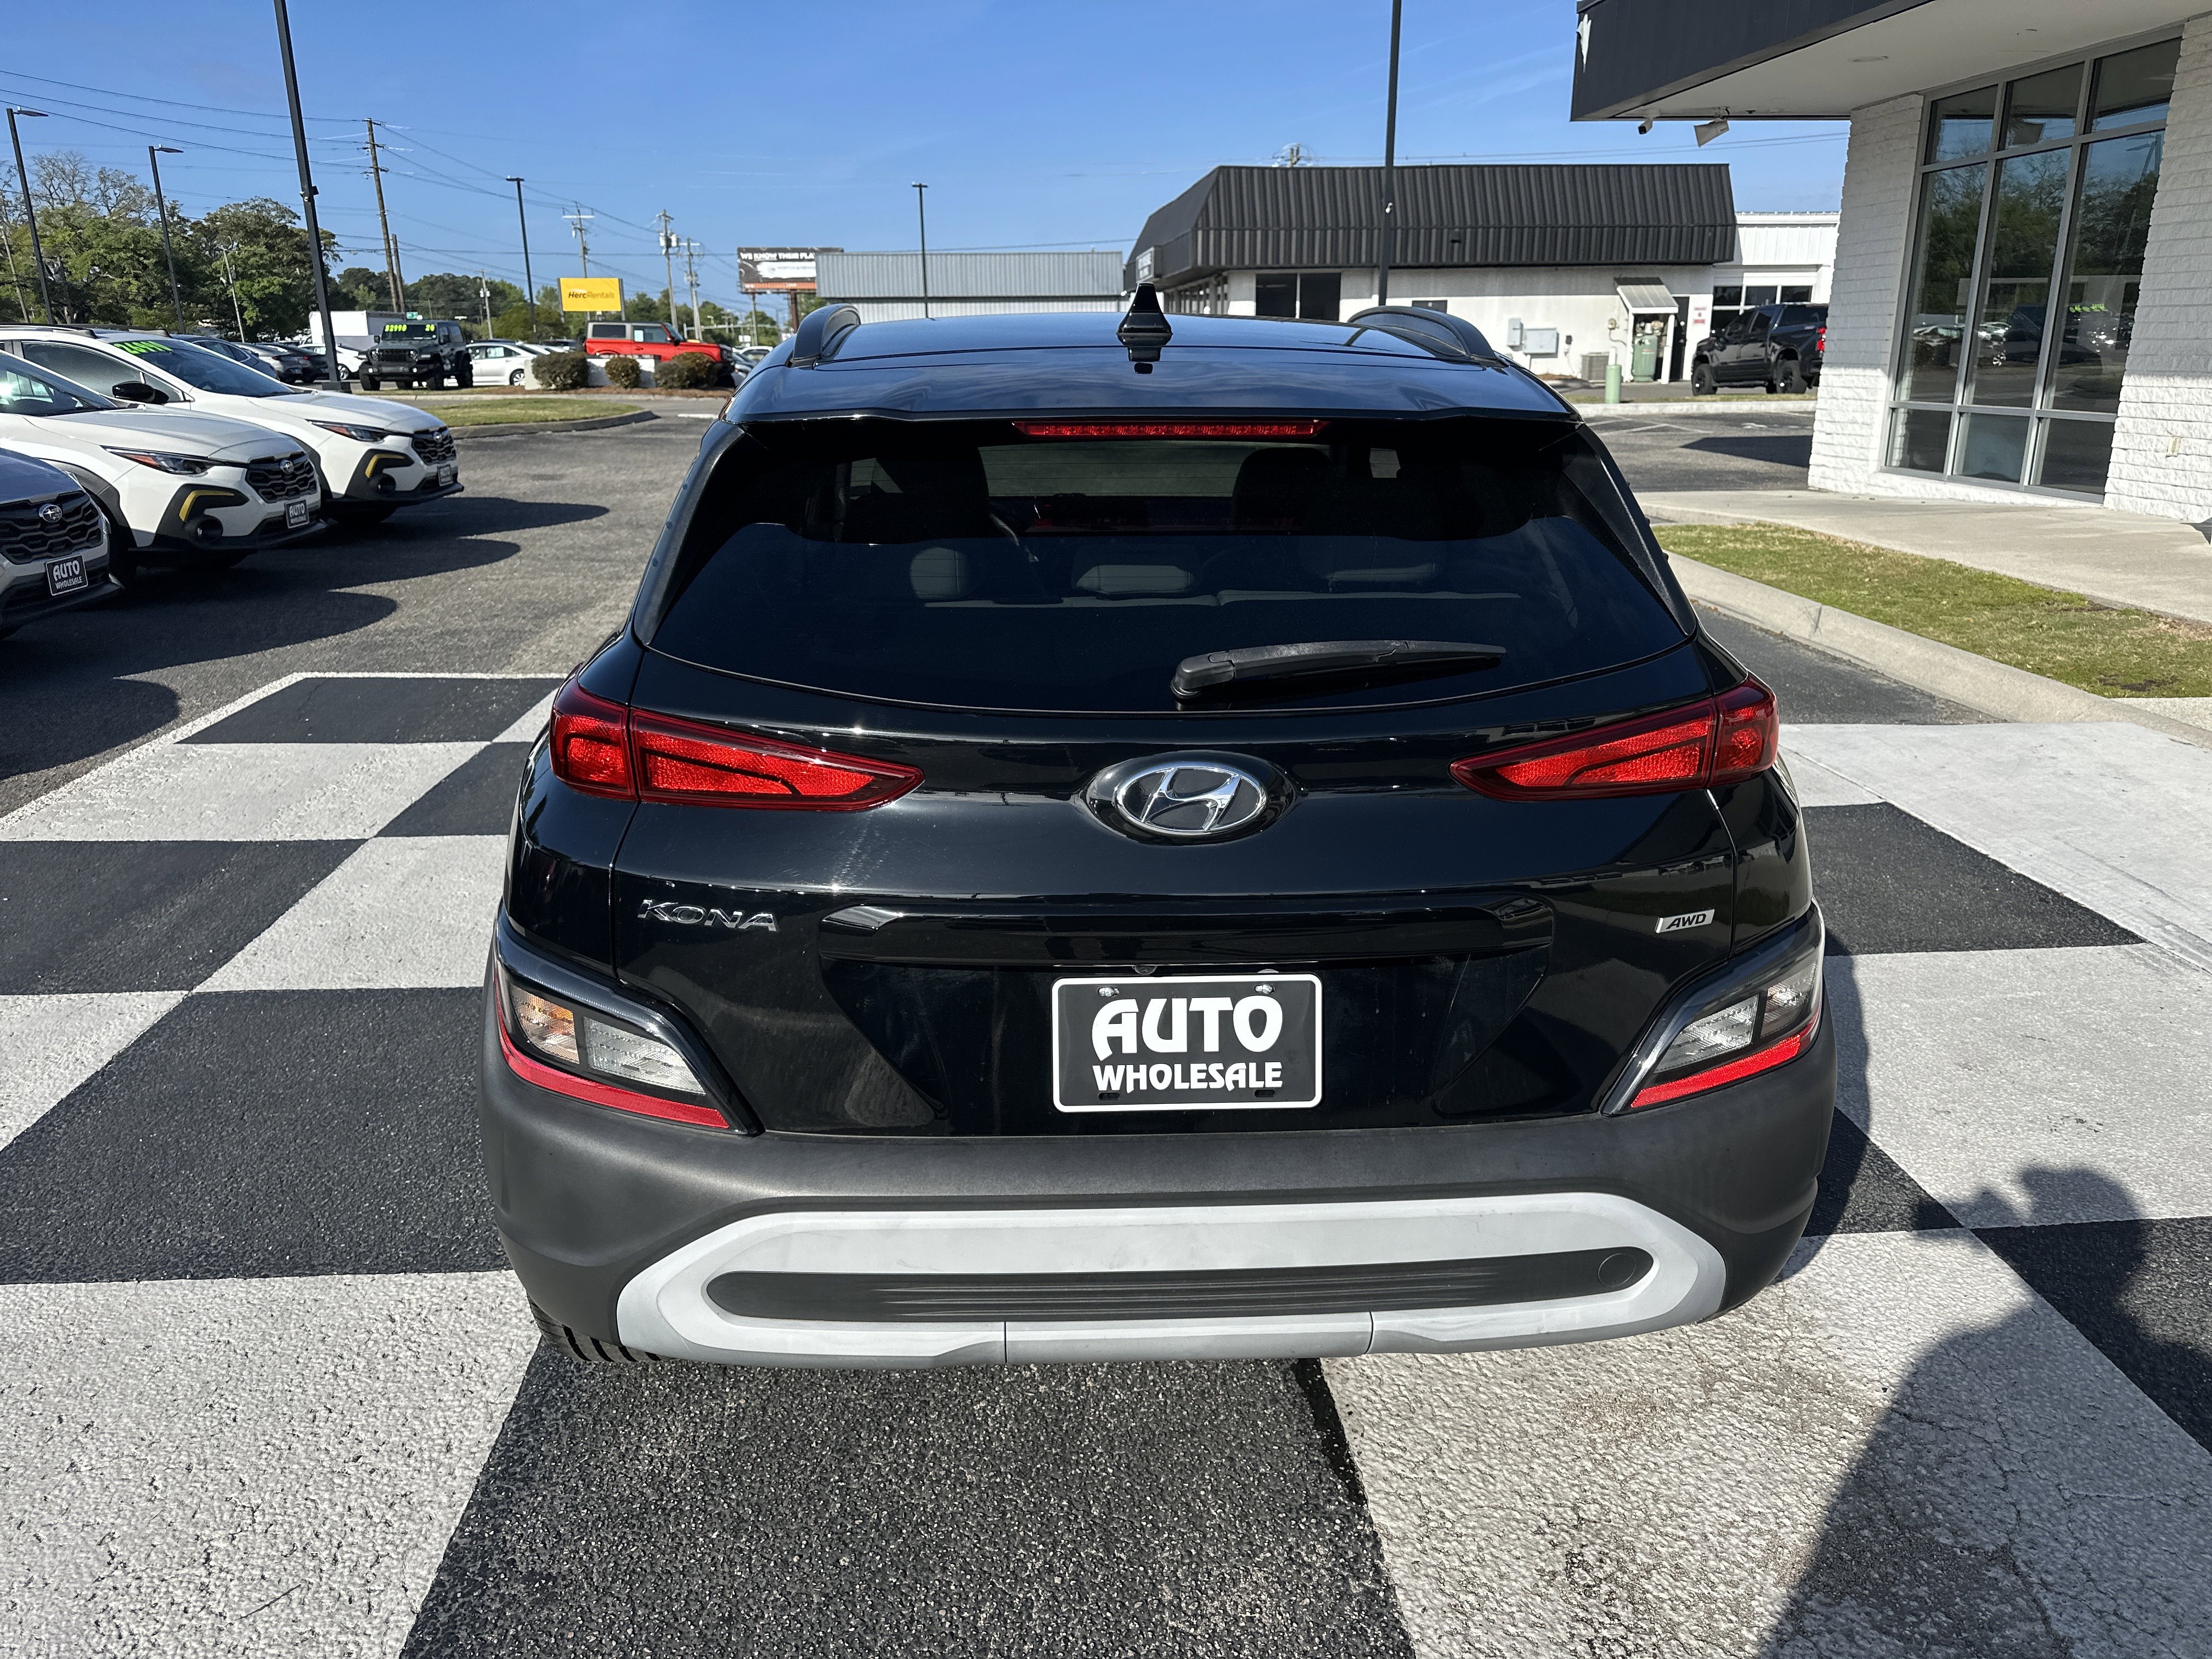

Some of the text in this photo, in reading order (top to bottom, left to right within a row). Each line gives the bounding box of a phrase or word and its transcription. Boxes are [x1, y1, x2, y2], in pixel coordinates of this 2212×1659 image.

[289, 503, 305, 518] AUTO
[53, 560, 80, 582] AUTO
[55, 576, 82, 589] WHOLESALE
[637, 899, 778, 932] KONA
[1666, 913, 1706, 929] AWD
[1092, 995, 1283, 1061] AUTO
[1092, 1062, 1283, 1093] WHOLESALE
